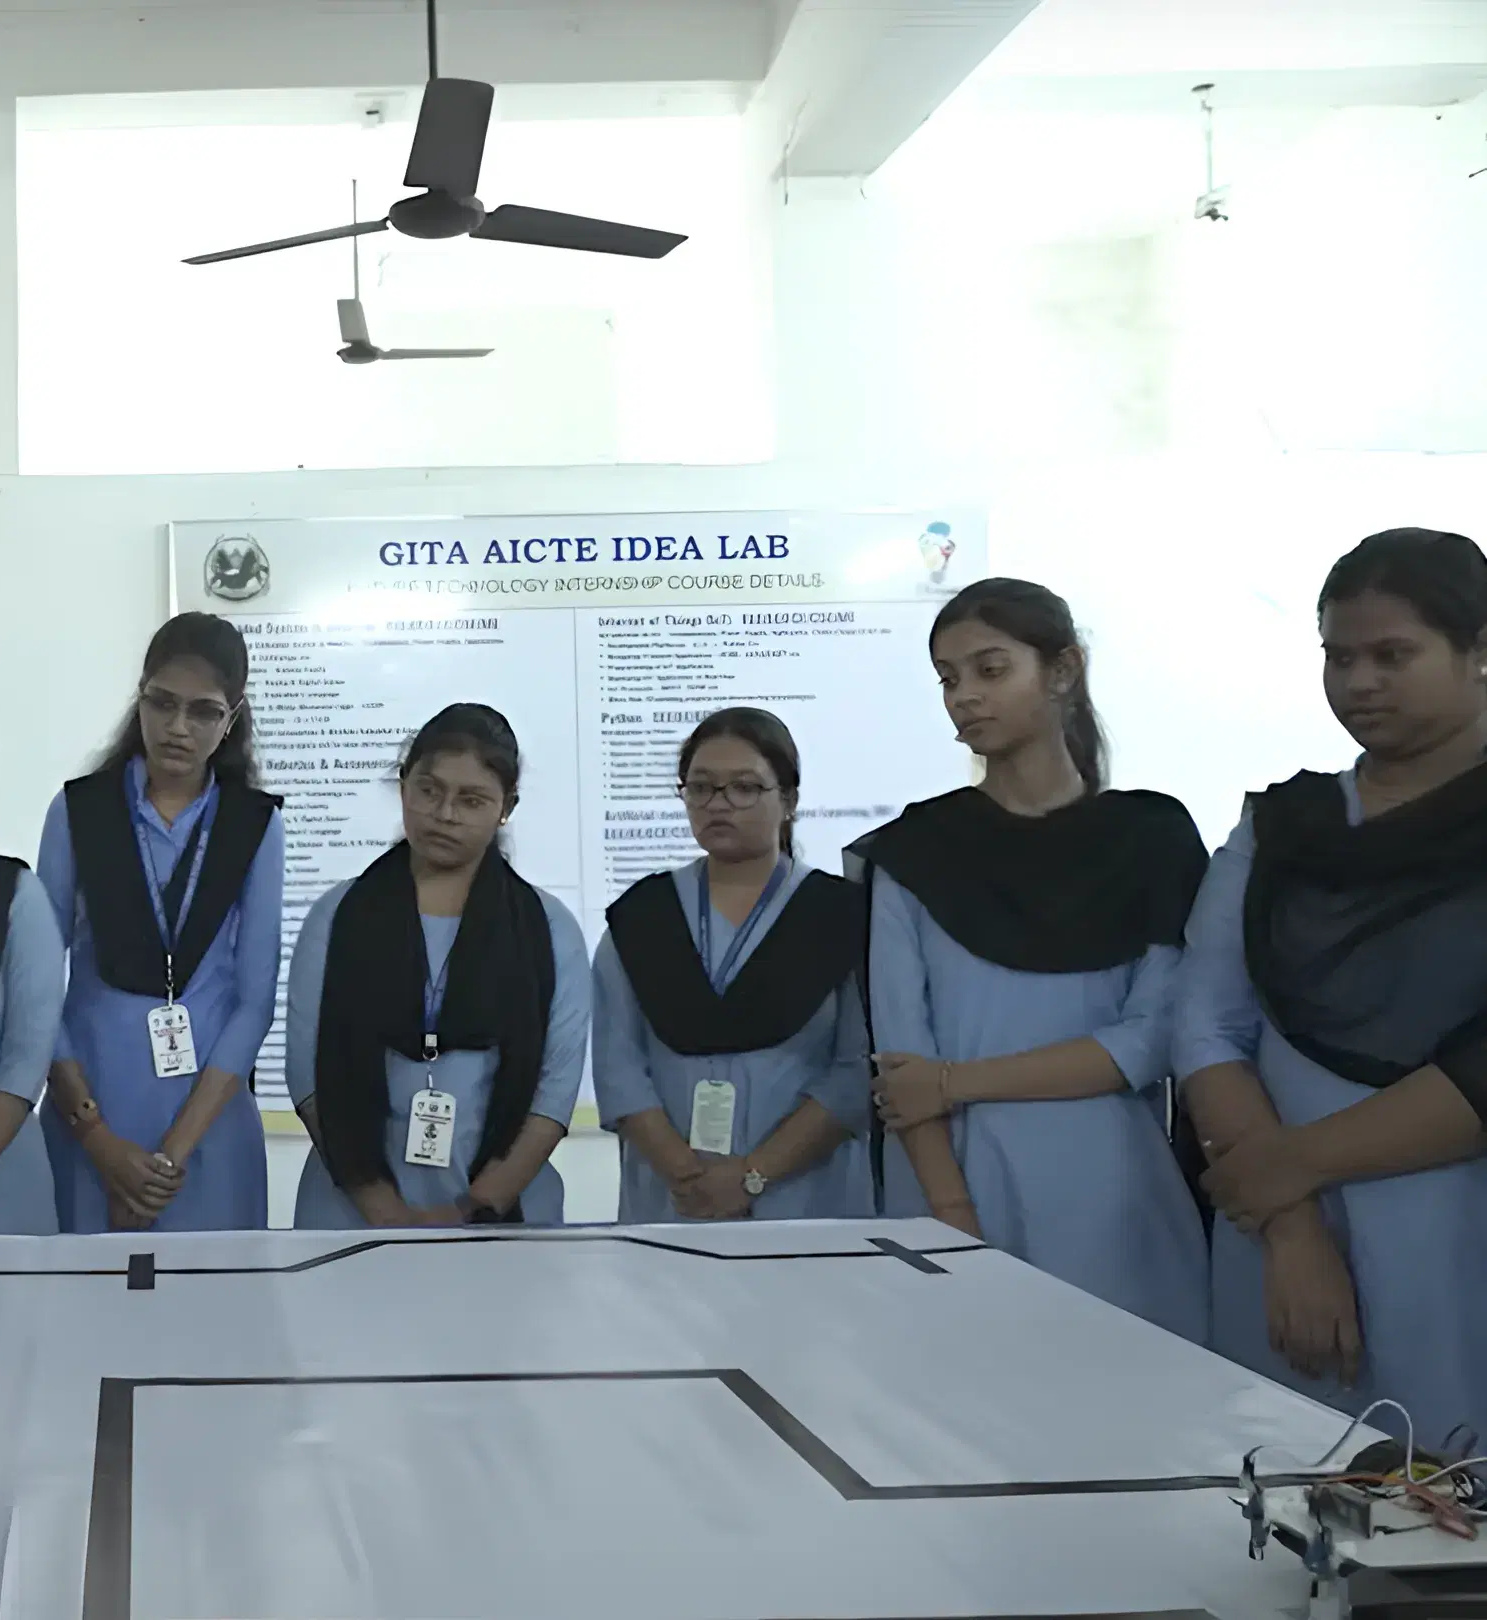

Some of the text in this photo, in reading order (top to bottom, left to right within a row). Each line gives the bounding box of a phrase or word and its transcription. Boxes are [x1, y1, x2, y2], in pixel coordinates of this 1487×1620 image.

[379, 534, 790, 567] GITA AICTE IDEA LAB
[667, 574, 744, 590] COURSE
